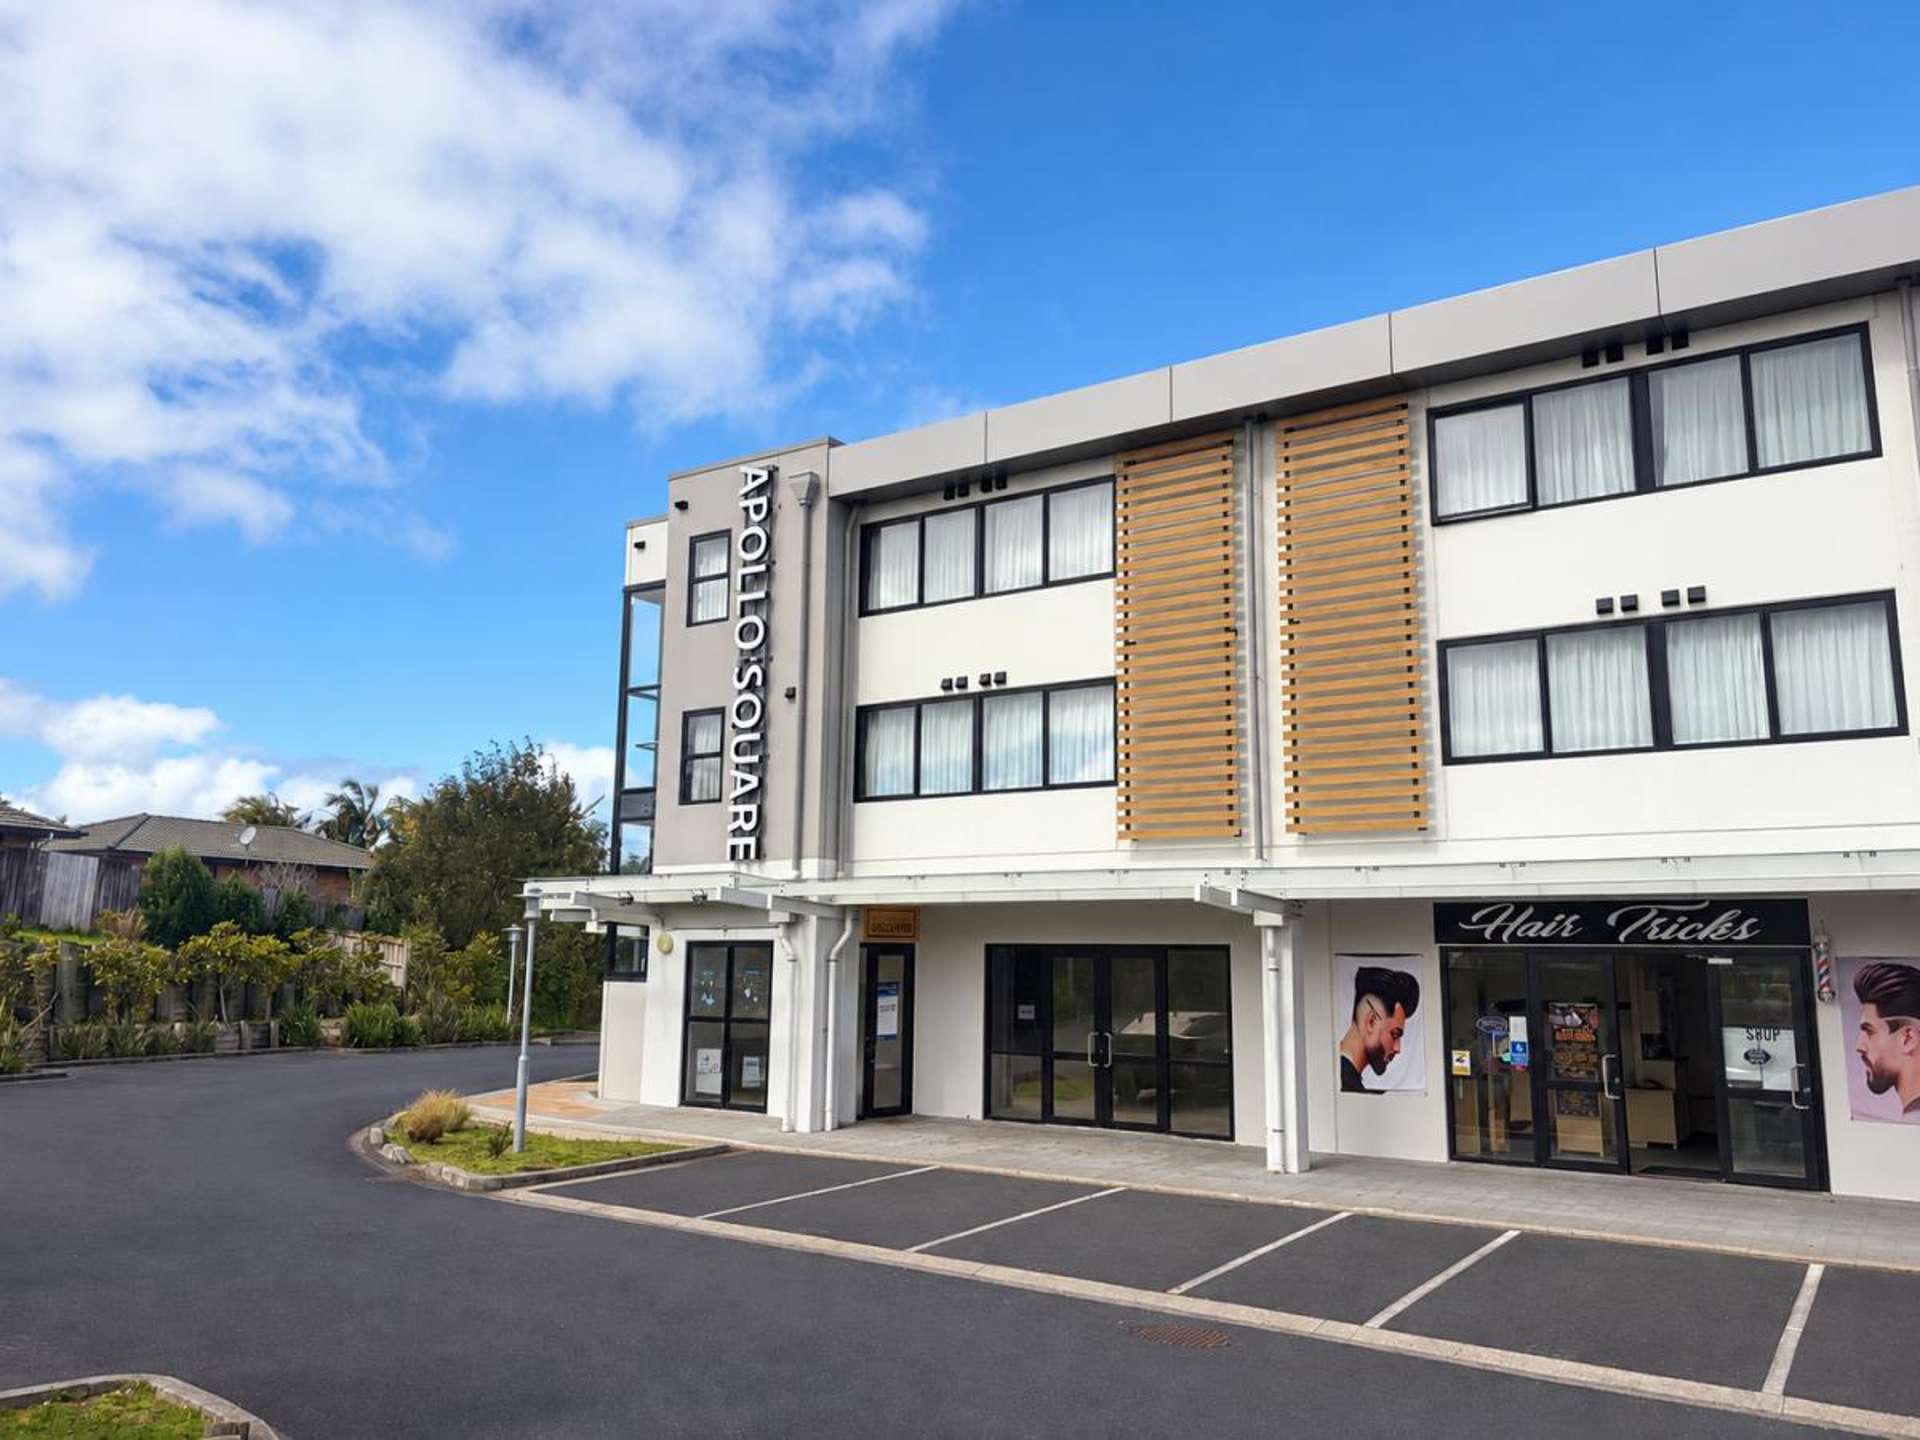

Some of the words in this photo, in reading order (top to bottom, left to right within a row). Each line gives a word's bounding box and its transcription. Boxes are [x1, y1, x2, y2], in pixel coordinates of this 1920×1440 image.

[735, 466, 769, 651] APOLLO
[727, 664, 763, 861] SQUARE
[1459, 904, 1583, 943] Hair
[1606, 900, 1761, 943] Tricks
